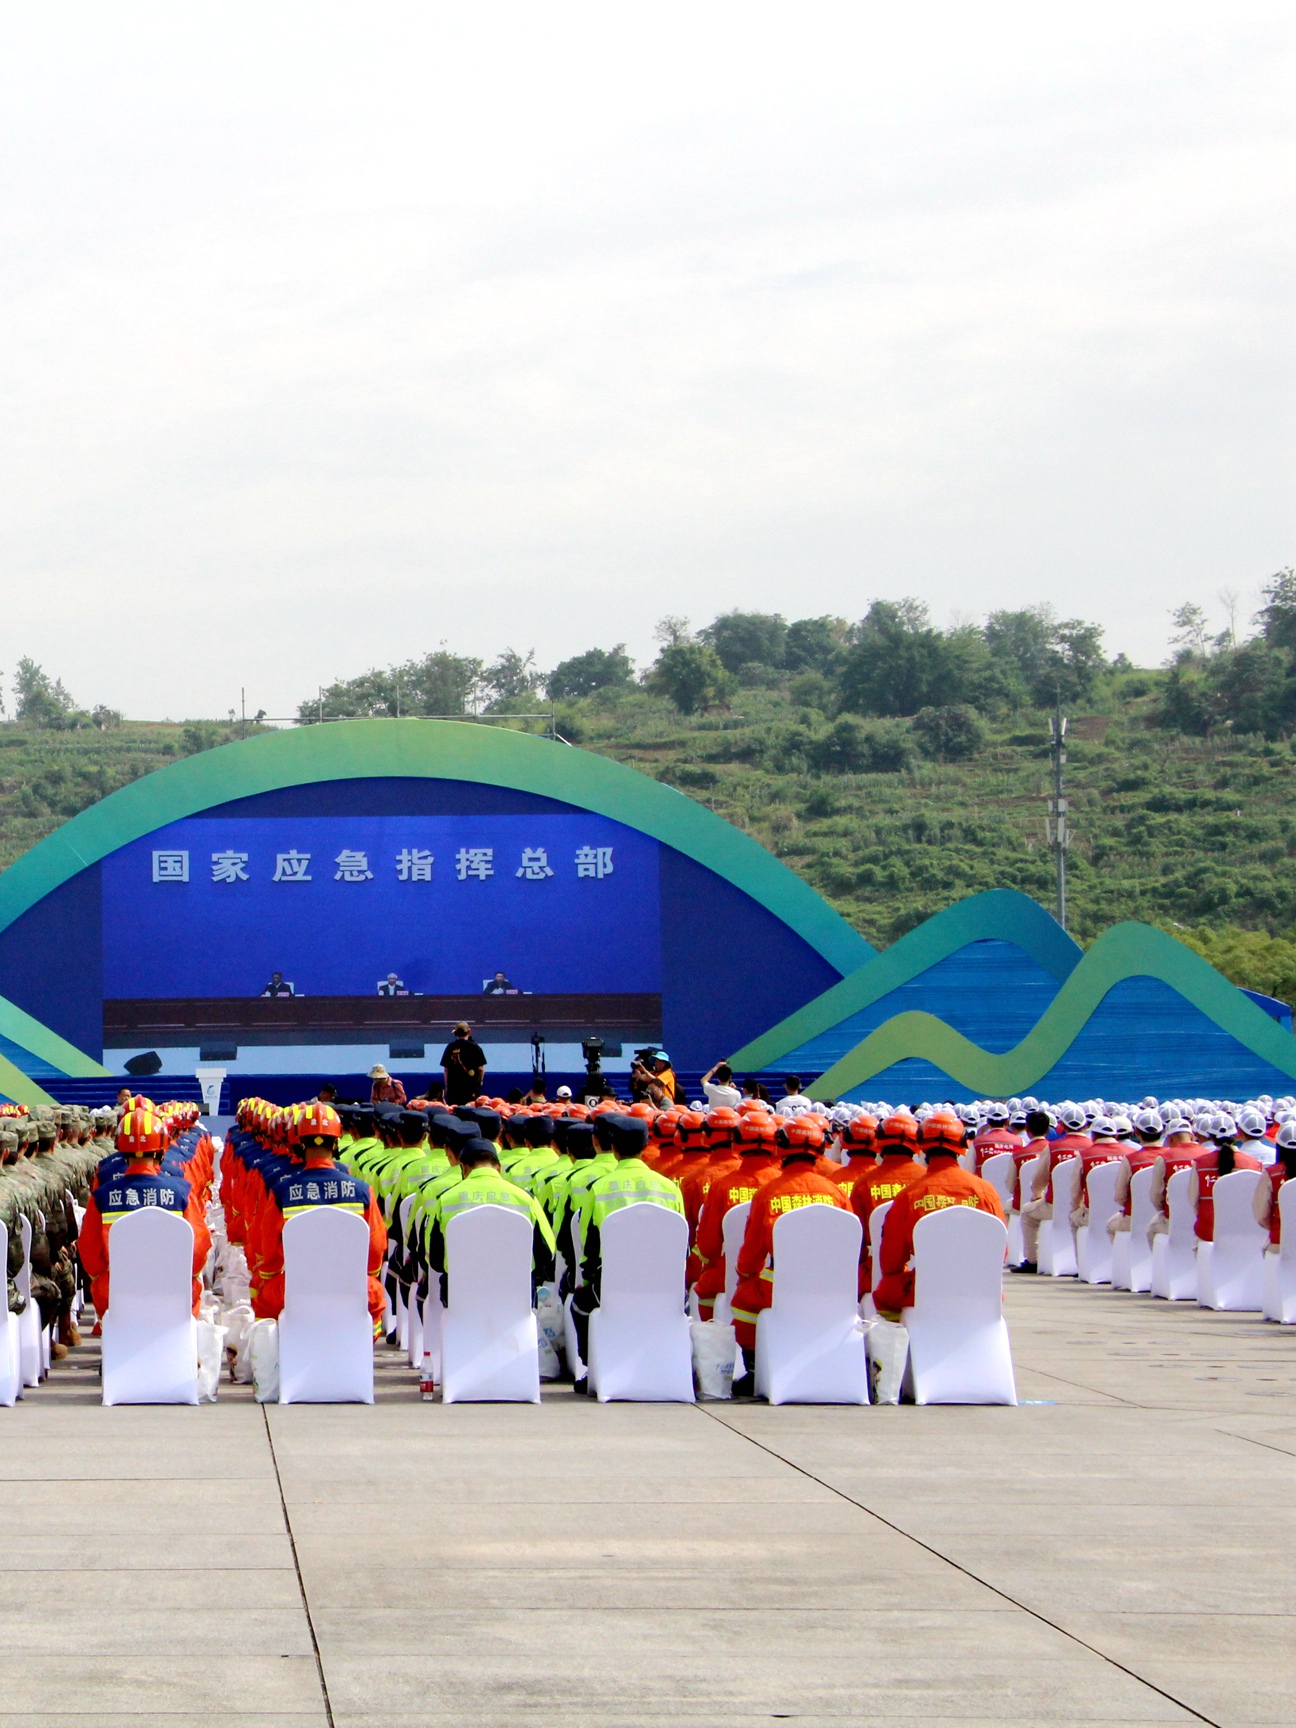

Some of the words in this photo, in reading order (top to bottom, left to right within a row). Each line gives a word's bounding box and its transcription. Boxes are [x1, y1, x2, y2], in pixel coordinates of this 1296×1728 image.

[151, 846, 615, 883] 国家应急指挥总部
[109, 1188, 175, 1206] 应急消防
[289, 1181, 356, 1201] 应急消防
